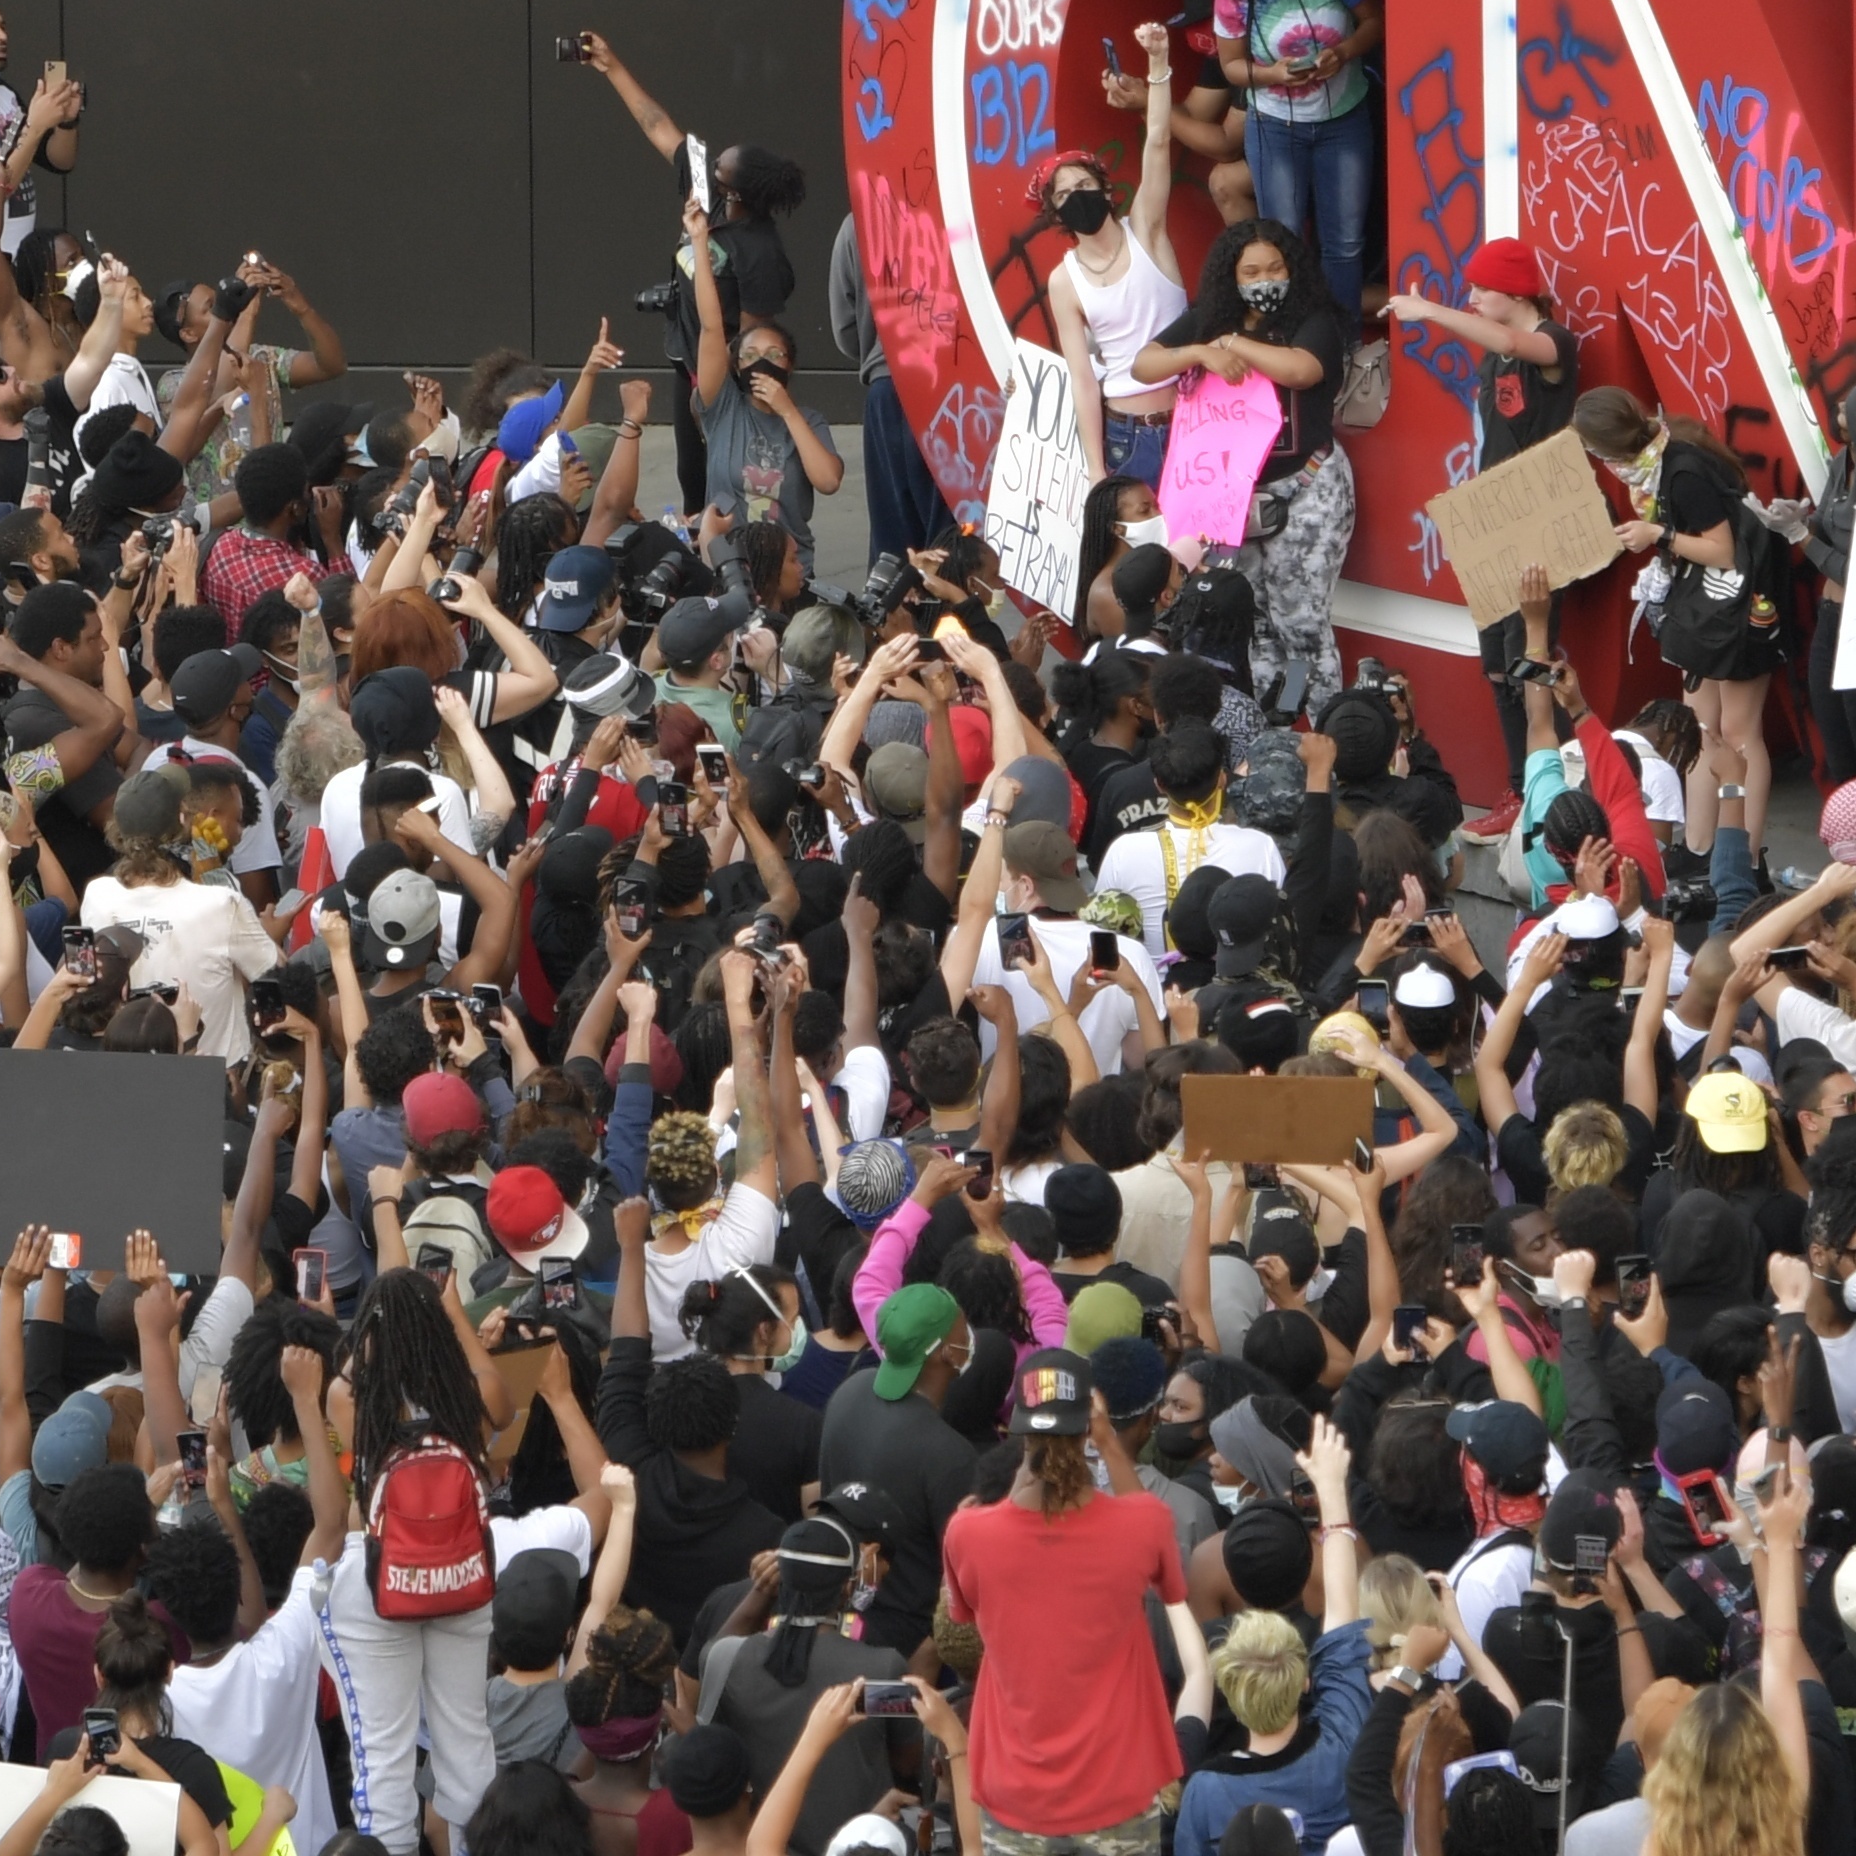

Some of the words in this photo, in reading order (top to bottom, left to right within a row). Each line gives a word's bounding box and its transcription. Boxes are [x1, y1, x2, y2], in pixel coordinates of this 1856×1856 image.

[1697, 75, 1768, 147] NO
[1728, 151, 1836, 267] COPS
[1024, 499, 1043, 536] IS
[1444, 466, 1544, 548] AMERICA
[1531, 447, 1584, 501] WAS
[385, 1563, 430, 1595] STEVE
[429, 1552, 486, 1595] MADDEN
